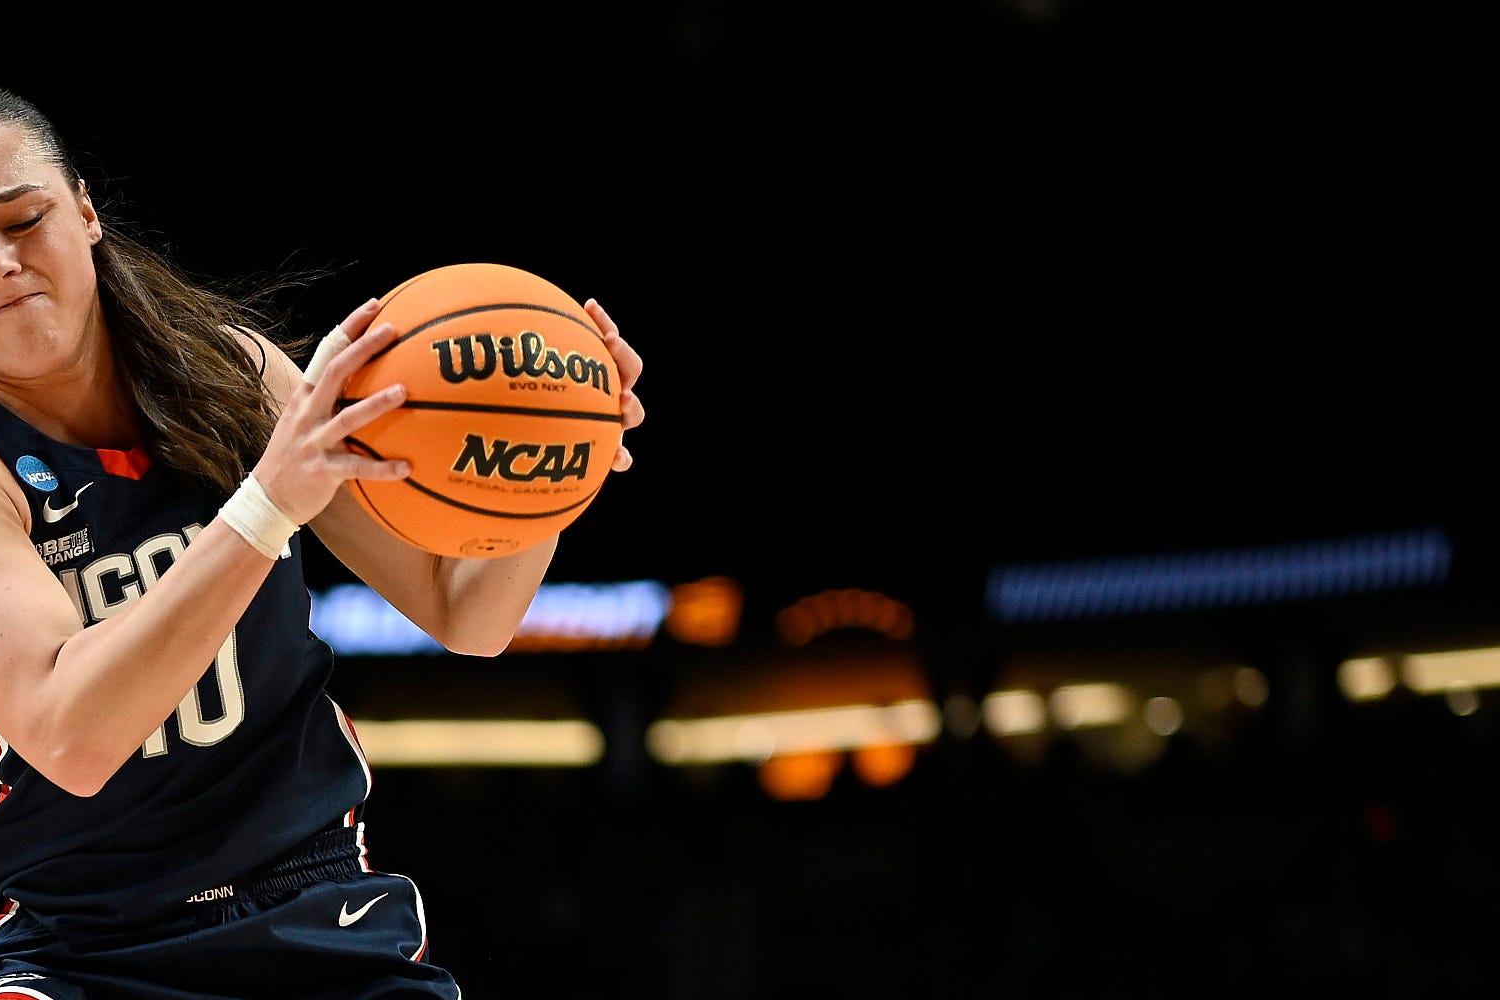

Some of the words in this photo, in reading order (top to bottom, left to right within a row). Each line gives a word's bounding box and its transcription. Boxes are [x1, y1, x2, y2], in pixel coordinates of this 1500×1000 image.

[430, 330, 611, 396] Wilson
[509, 382, 538, 391] EVO
[542, 383, 567, 393] NXT
[450, 433, 591, 484] NCAA
[26, 471, 56, 484] NCAA
[43, 541, 90, 566] HANGE
